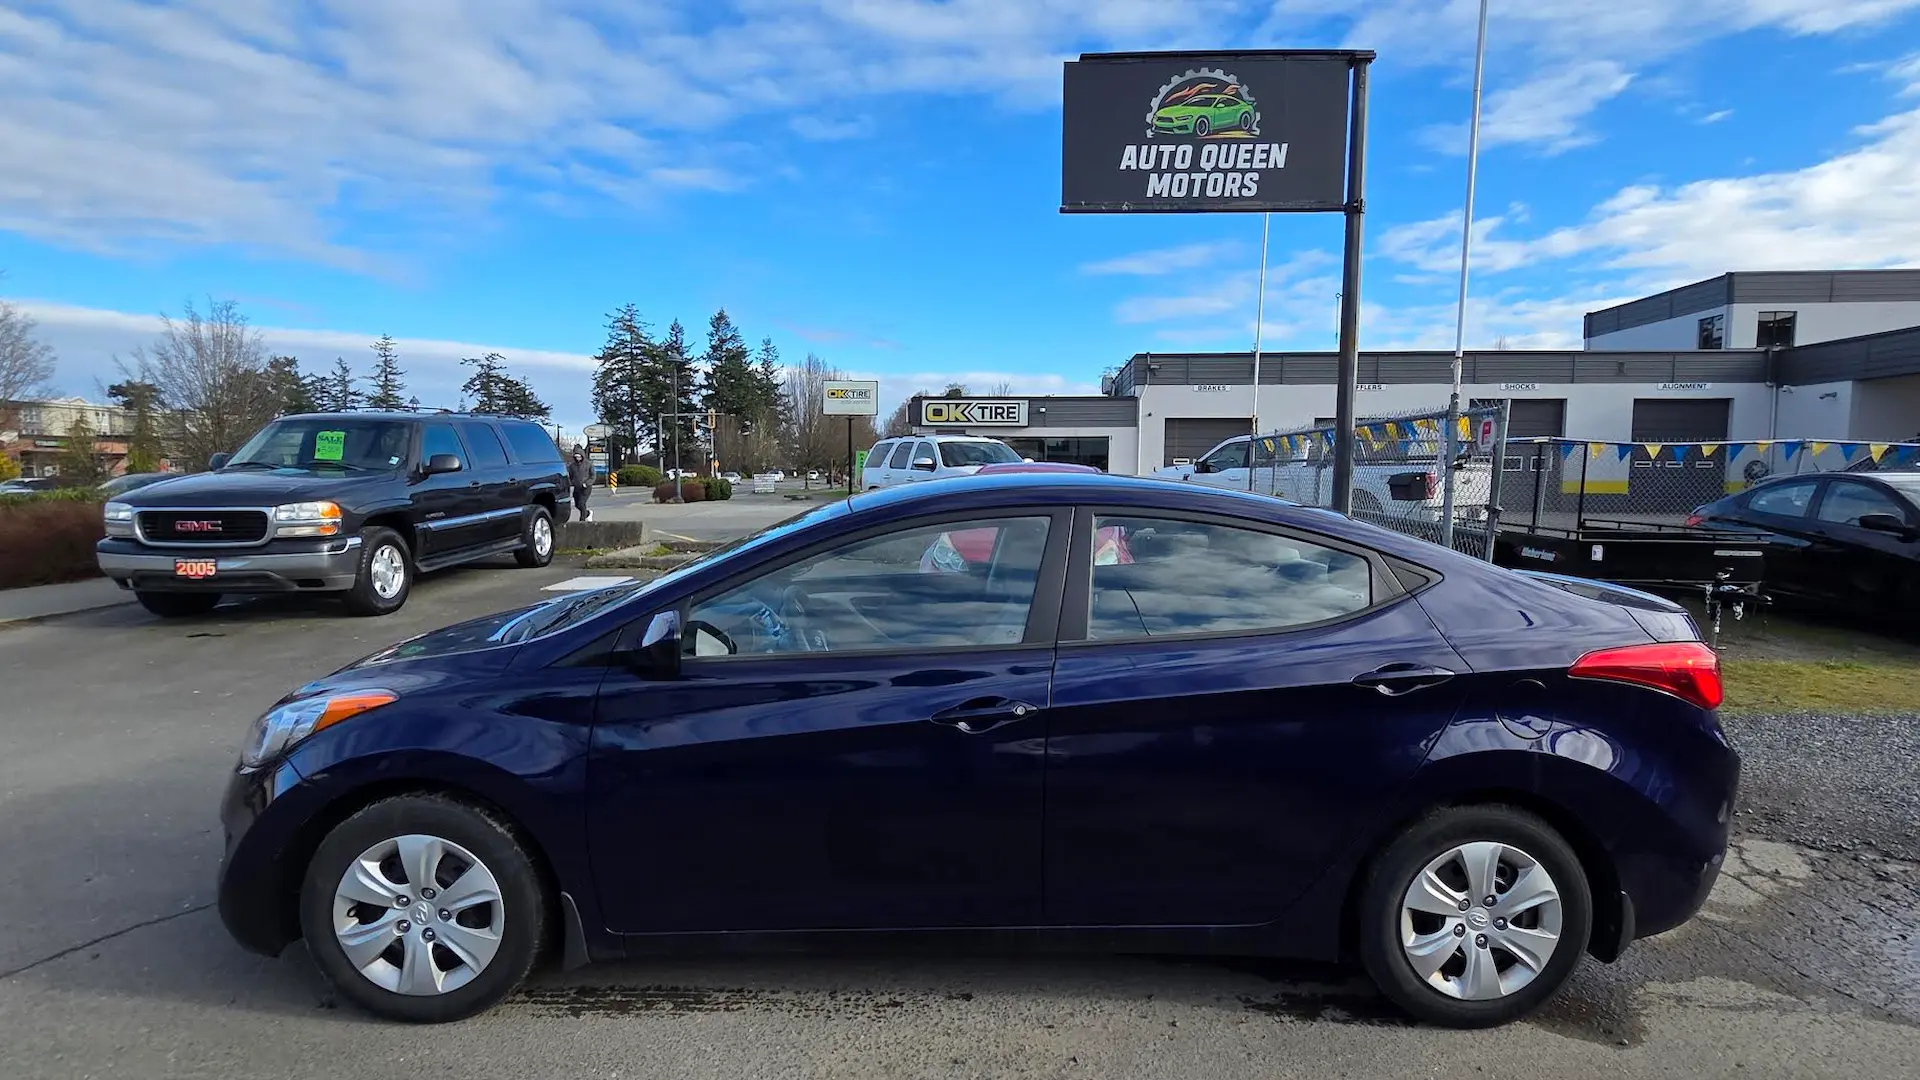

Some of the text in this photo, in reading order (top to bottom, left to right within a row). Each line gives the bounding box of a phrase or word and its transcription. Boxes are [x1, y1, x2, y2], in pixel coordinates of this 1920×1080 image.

[1119, 143, 1288, 172] AUTO QUEEN
[1146, 172, 1260, 198] MOTORS
[827, 389, 869, 399] OK TIRE
[925, 402, 1017, 422] OK TIRE
[175, 520, 222, 532] GMC
[175, 562, 217, 576] 2005
